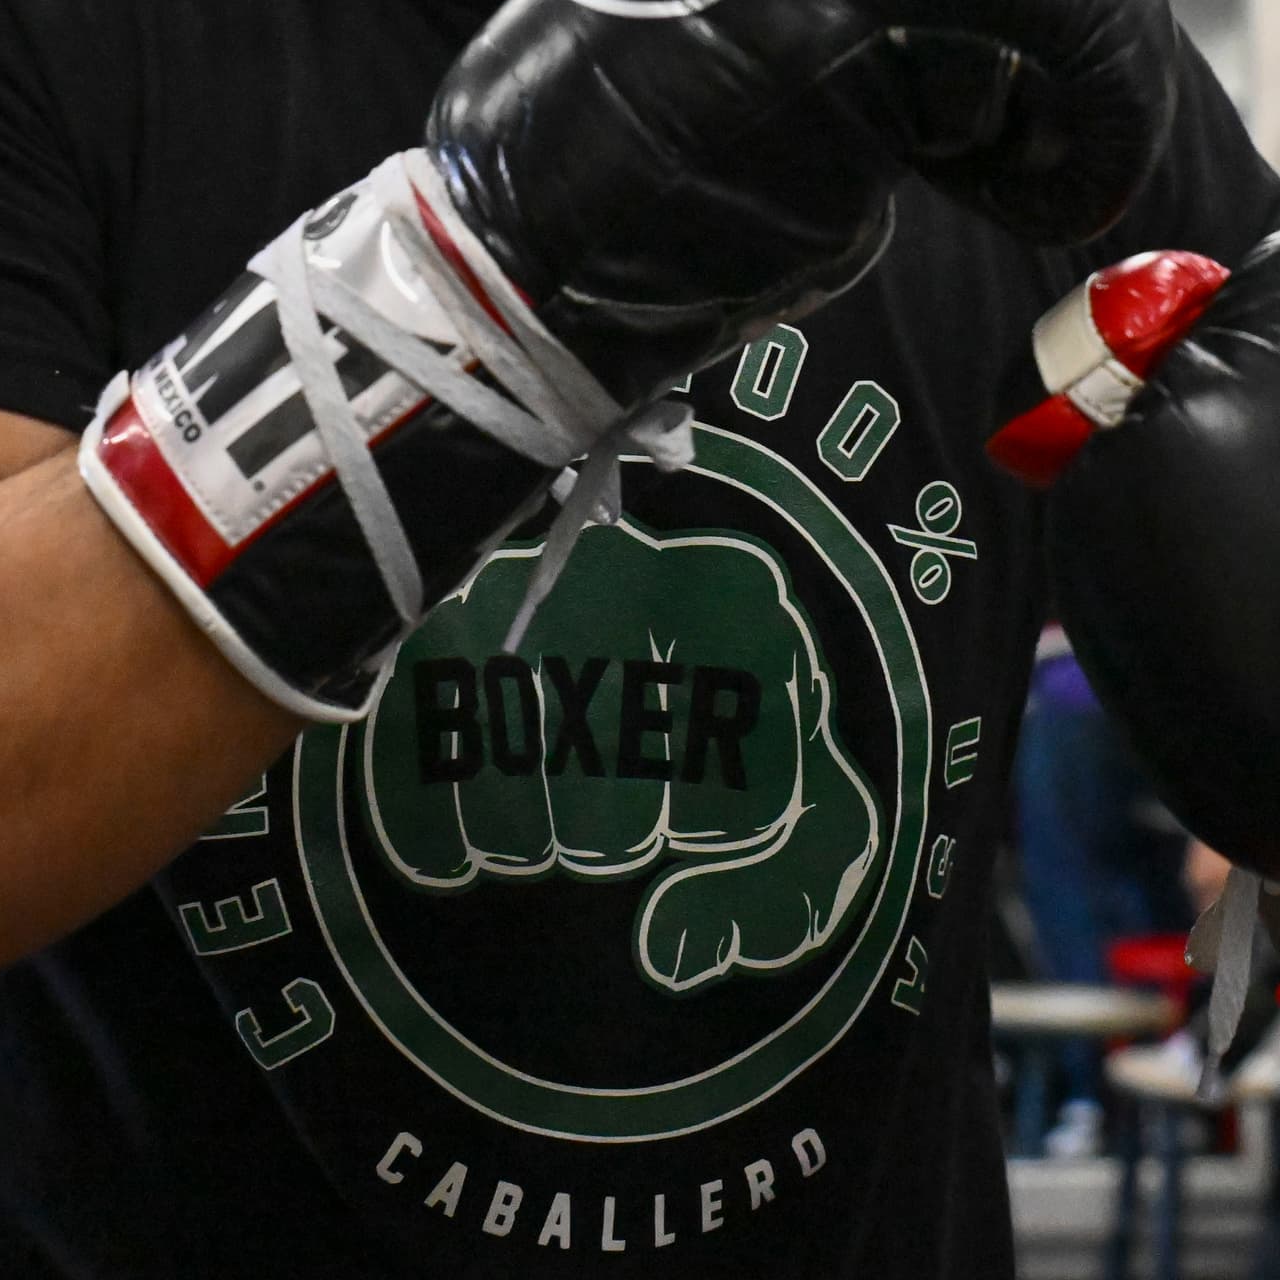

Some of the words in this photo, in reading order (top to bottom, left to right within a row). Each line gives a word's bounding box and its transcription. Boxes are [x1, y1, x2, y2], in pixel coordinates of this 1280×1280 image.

[154, 365, 202, 445] MEXICO
[672, 323, 978, 605] 00%
[414, 656, 762, 791] BOXER
[376, 1128, 827, 1251] CABALLERO
